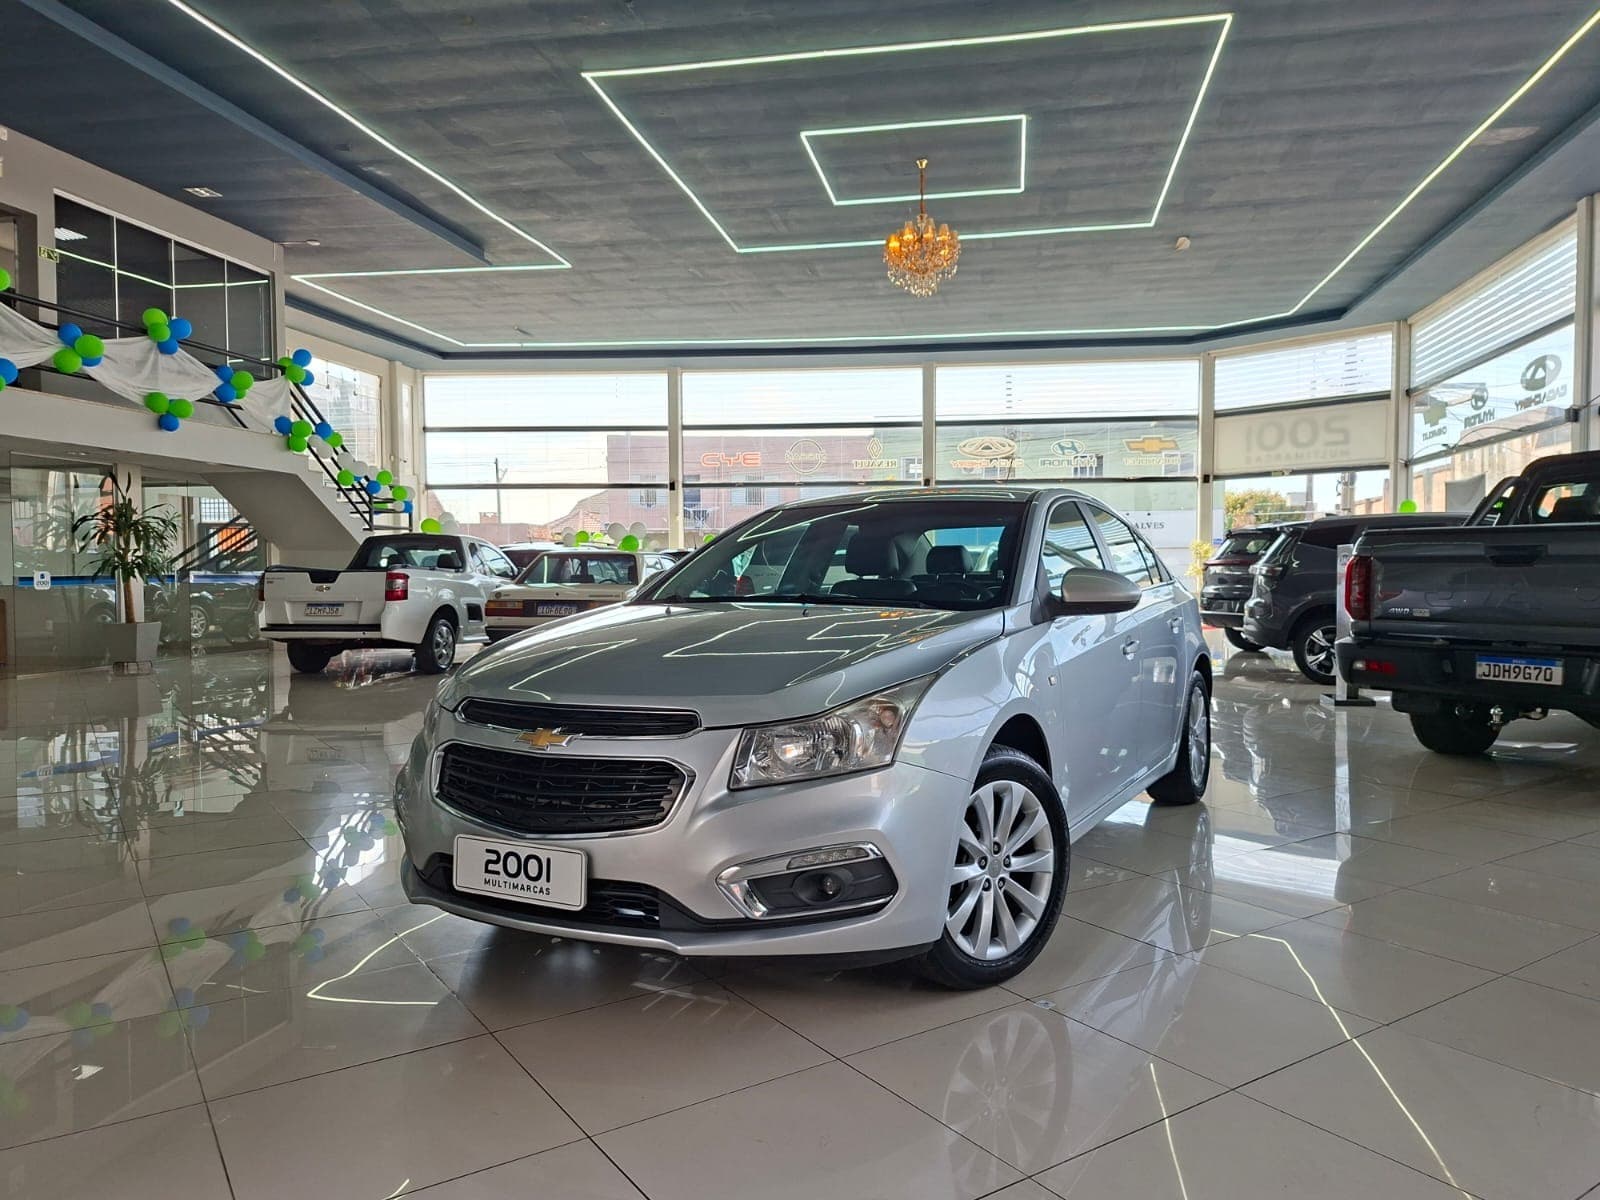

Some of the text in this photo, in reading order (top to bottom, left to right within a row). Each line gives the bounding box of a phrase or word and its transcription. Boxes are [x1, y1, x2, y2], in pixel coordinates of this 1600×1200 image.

[1482, 663, 1553, 682] JDH9G70
[484, 848, 551, 883] 2001
[484, 877, 551, 895] MULTIMARCAS
